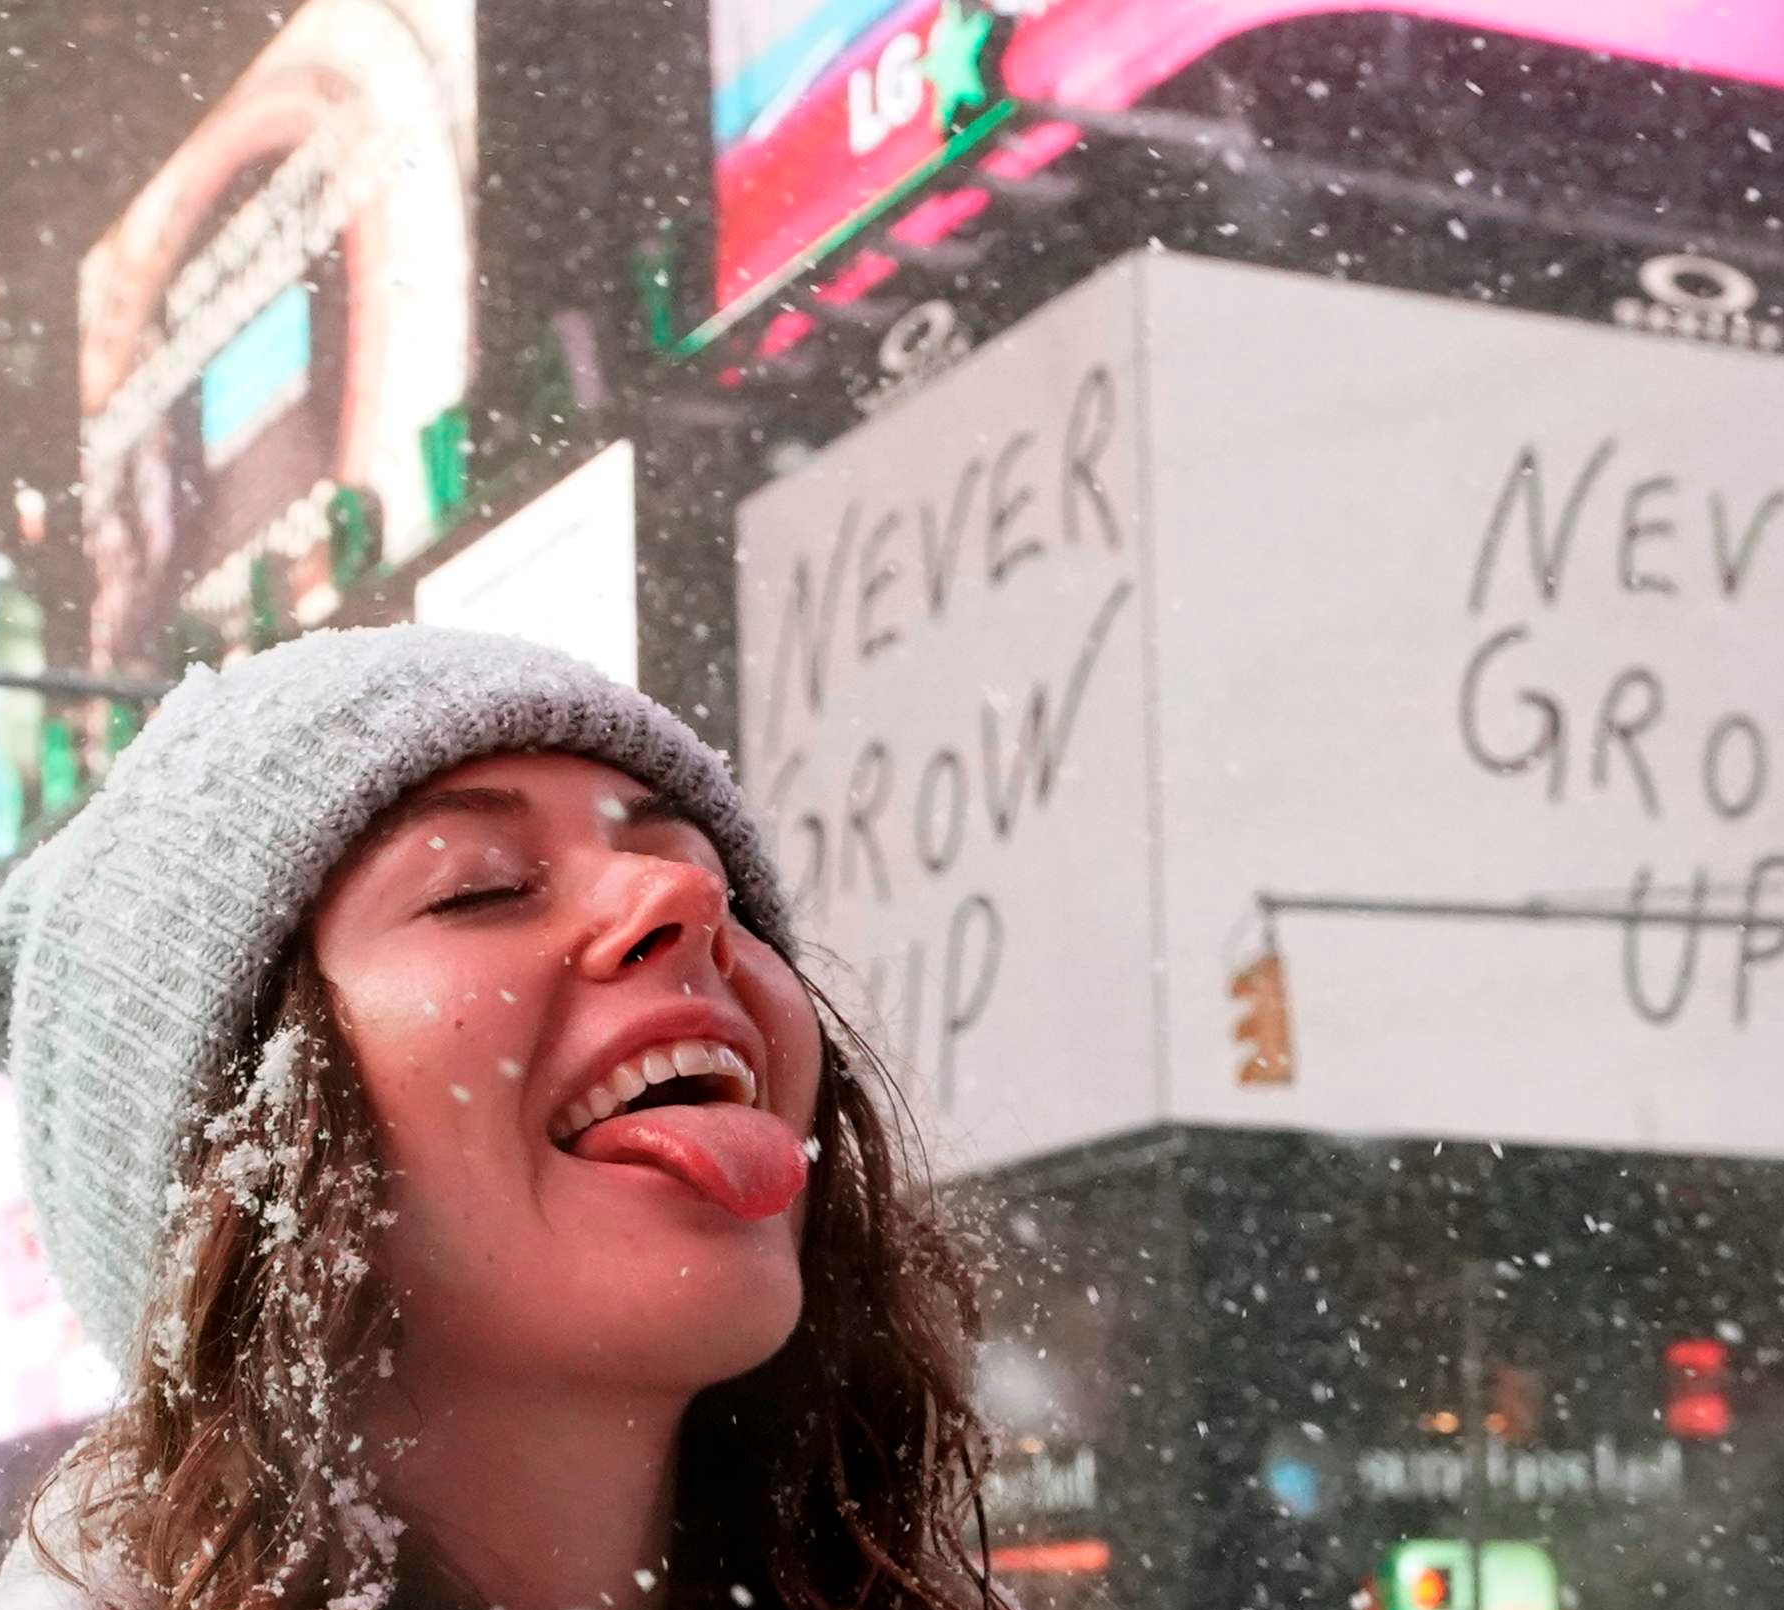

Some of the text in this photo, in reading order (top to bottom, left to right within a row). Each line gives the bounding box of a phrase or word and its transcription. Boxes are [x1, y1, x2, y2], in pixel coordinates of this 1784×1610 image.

[848, 31, 924, 156] LG
[763, 361, 1126, 760] NEVER
[767, 579, 1134, 922] GROW
